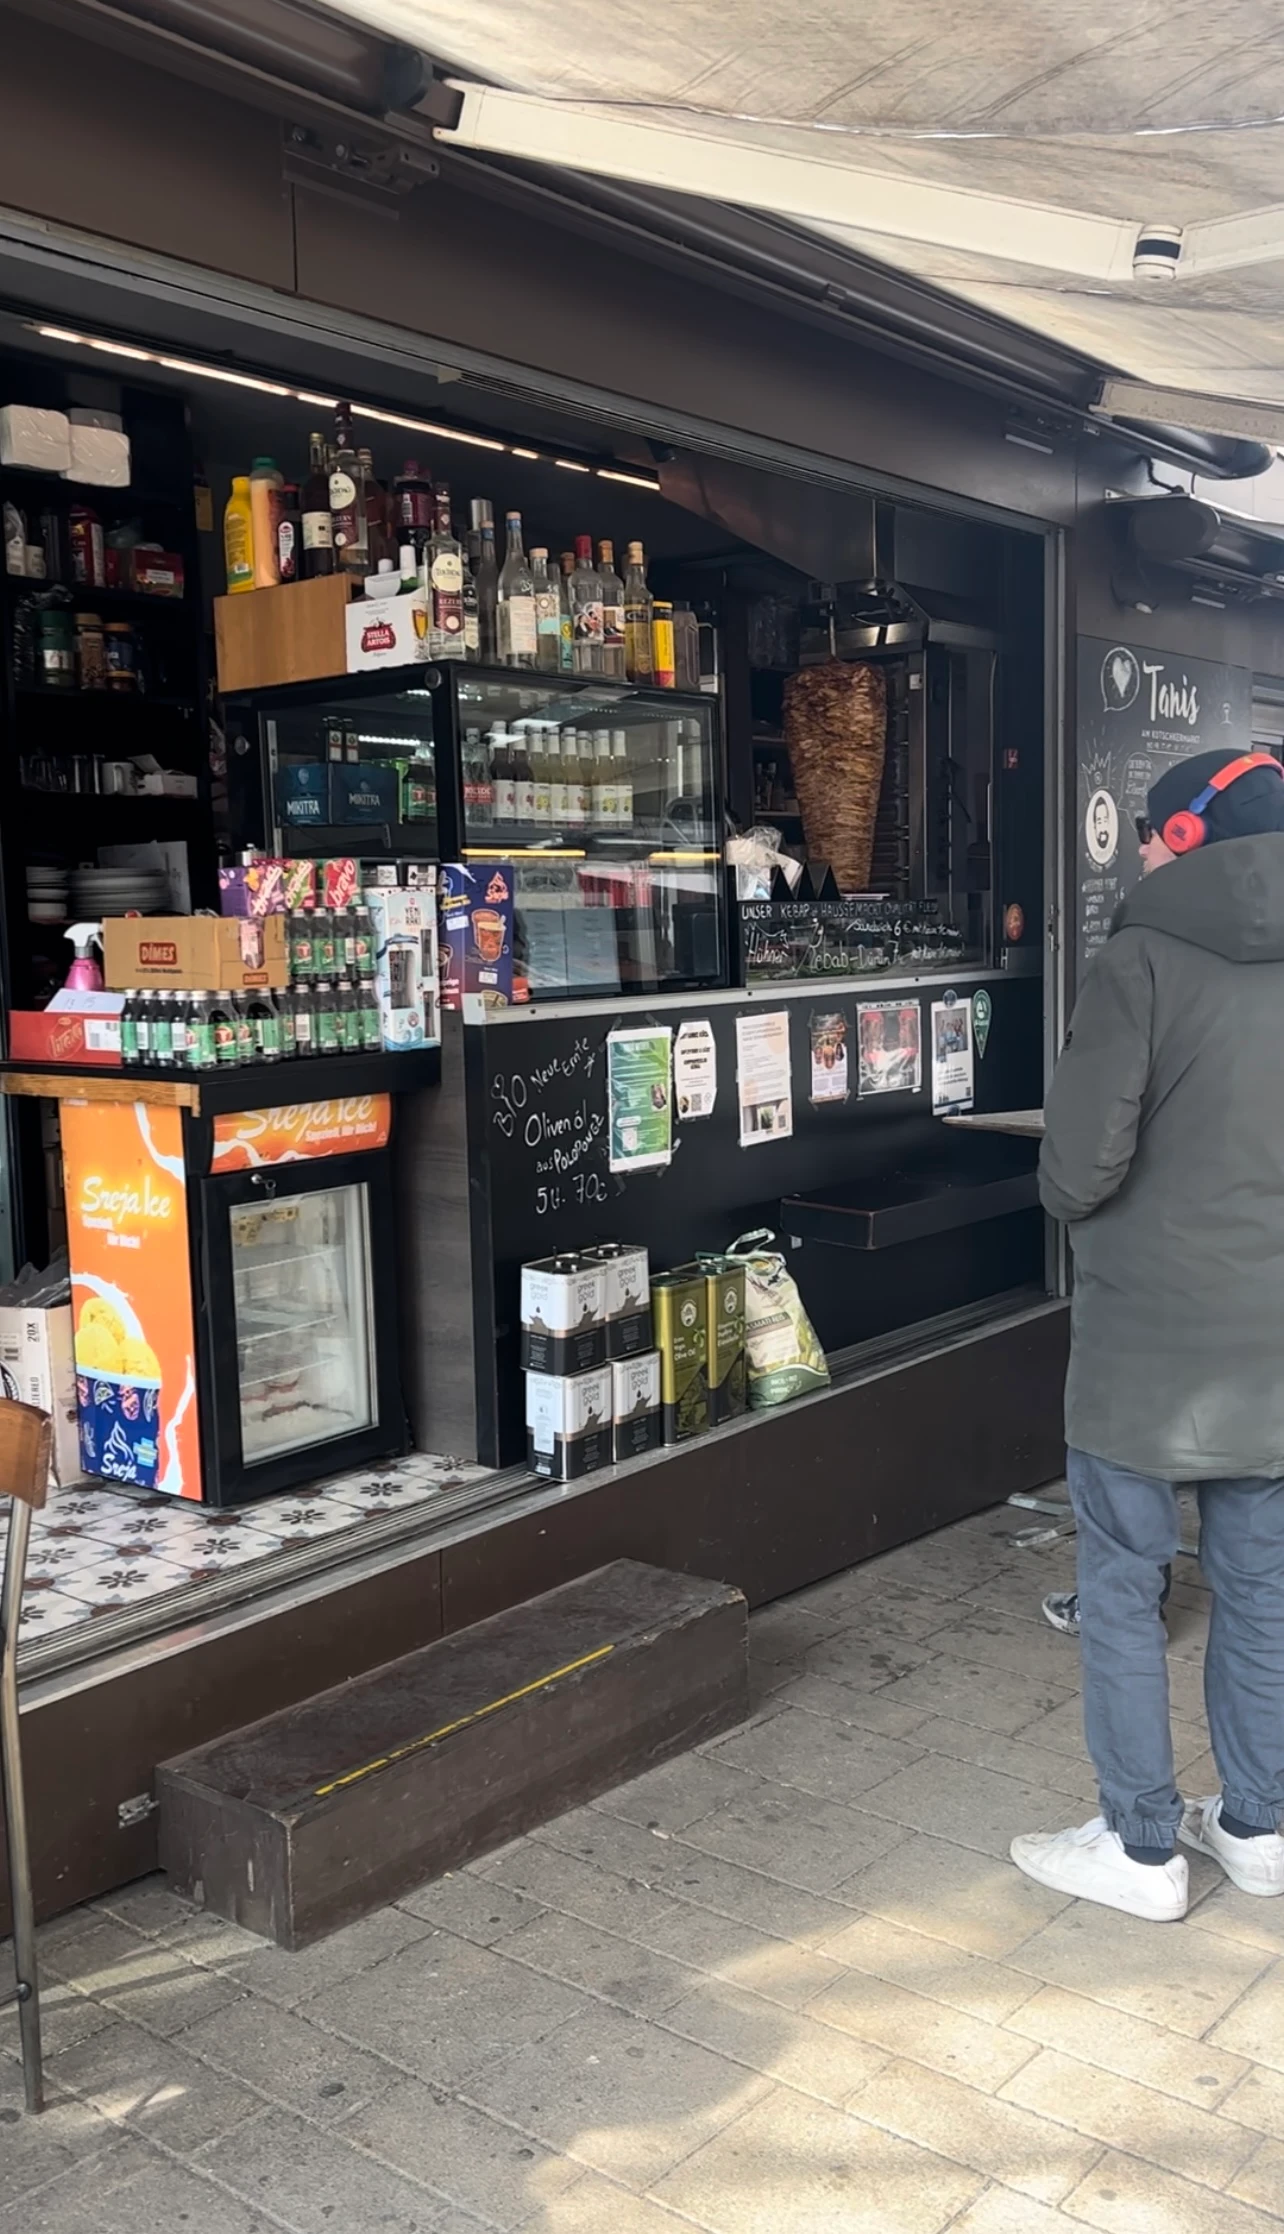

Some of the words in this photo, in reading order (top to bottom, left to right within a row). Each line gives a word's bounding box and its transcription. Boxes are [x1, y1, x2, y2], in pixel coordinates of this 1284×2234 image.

[366, 629, 390, 639] STELLA
[366, 637, 391, 647] ARTOIS
[1143, 660, 1200, 725] Tanis
[286, 800, 320, 816] MIKITRA
[348, 793, 381, 806] MIKITRA
[328, 860, 355, 907] bravo
[741, 904, 772, 919] UNSER
[894, 919, 902, 936] 6
[530, 1058, 561, 1093] Neue
[561, 1037, 590, 1077] Ernte
[336, 1096, 373, 1123] Ice
[81, 1176, 141, 1225] Sreja
[144, 1174, 172, 1218] Ice
[27, 1322, 38, 1342] 20X
[674, 1352, 687, 1361] Olive
